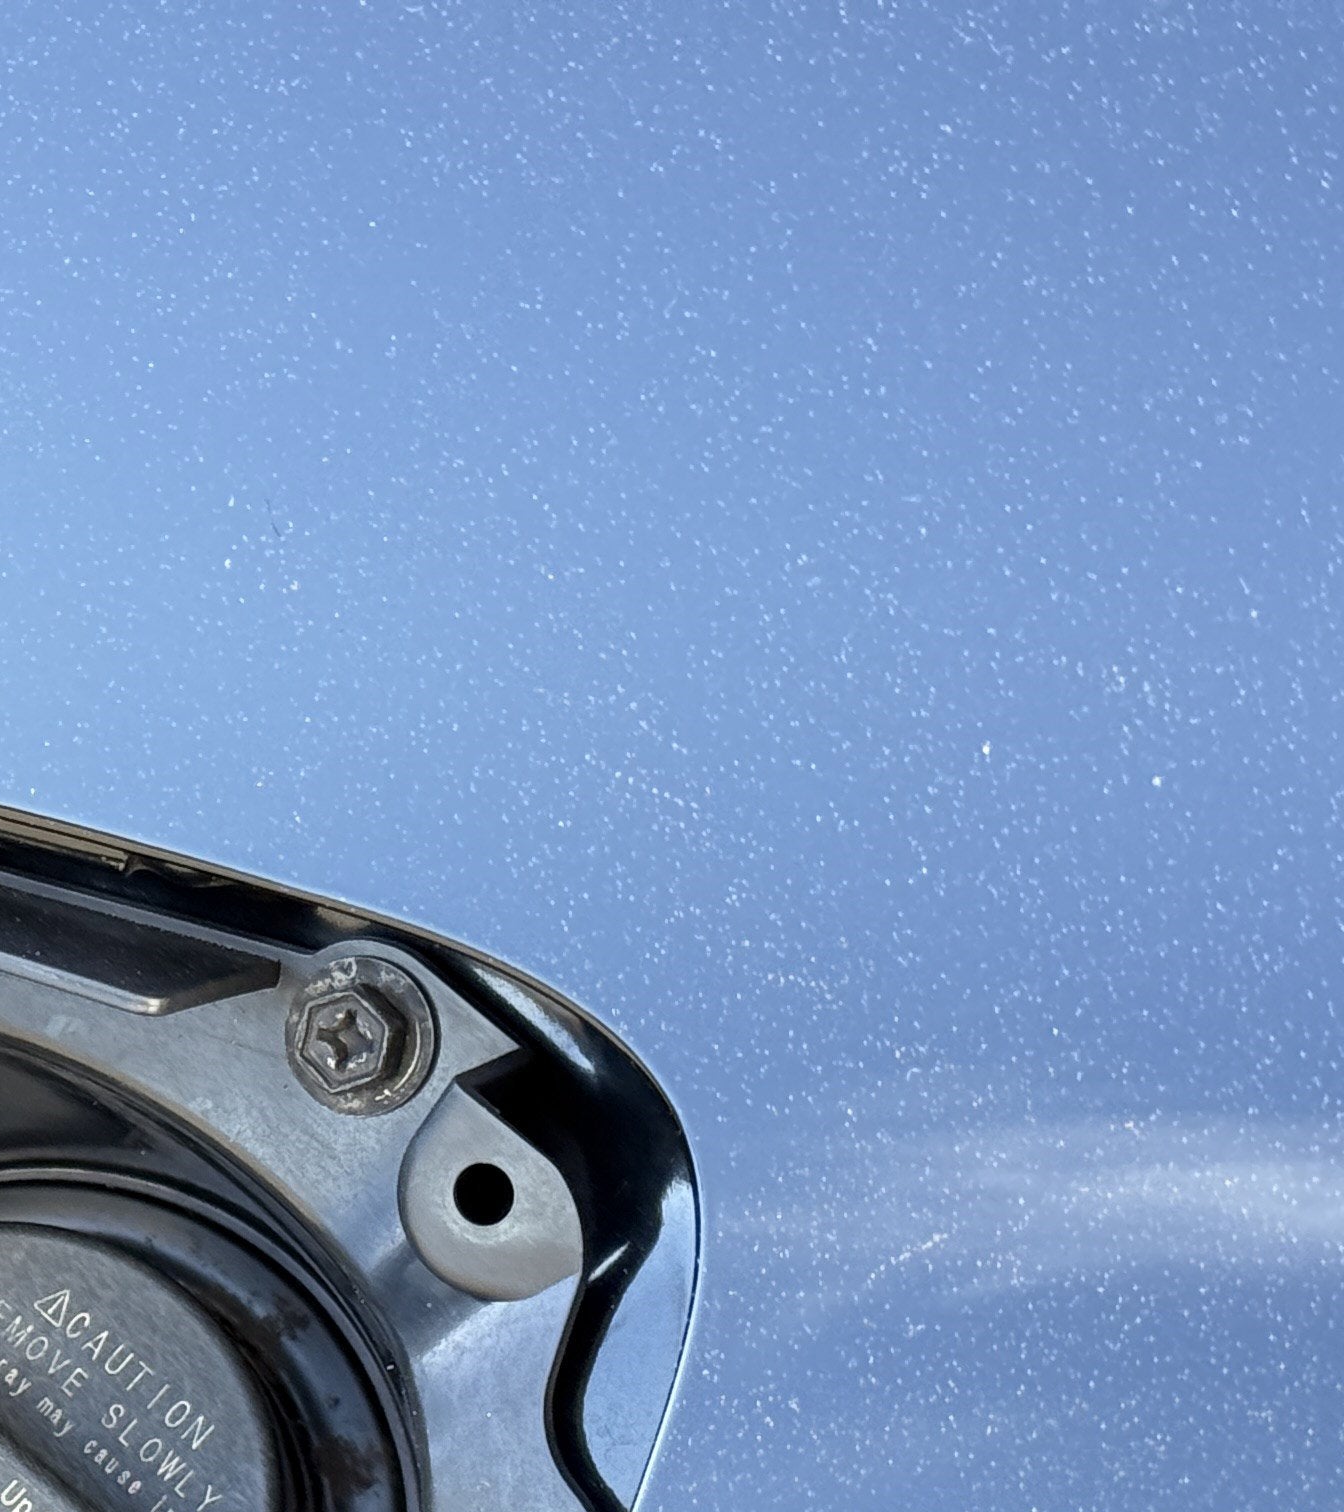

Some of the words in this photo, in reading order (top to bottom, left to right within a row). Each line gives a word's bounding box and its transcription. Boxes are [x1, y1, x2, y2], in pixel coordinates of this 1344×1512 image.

[65, 1311, 215, 1450] CAUTION
[36, 1396, 75, 1438] may
[83, 1439, 143, 1496] cause
[101, 1403, 223, 1512] SLOWLY
